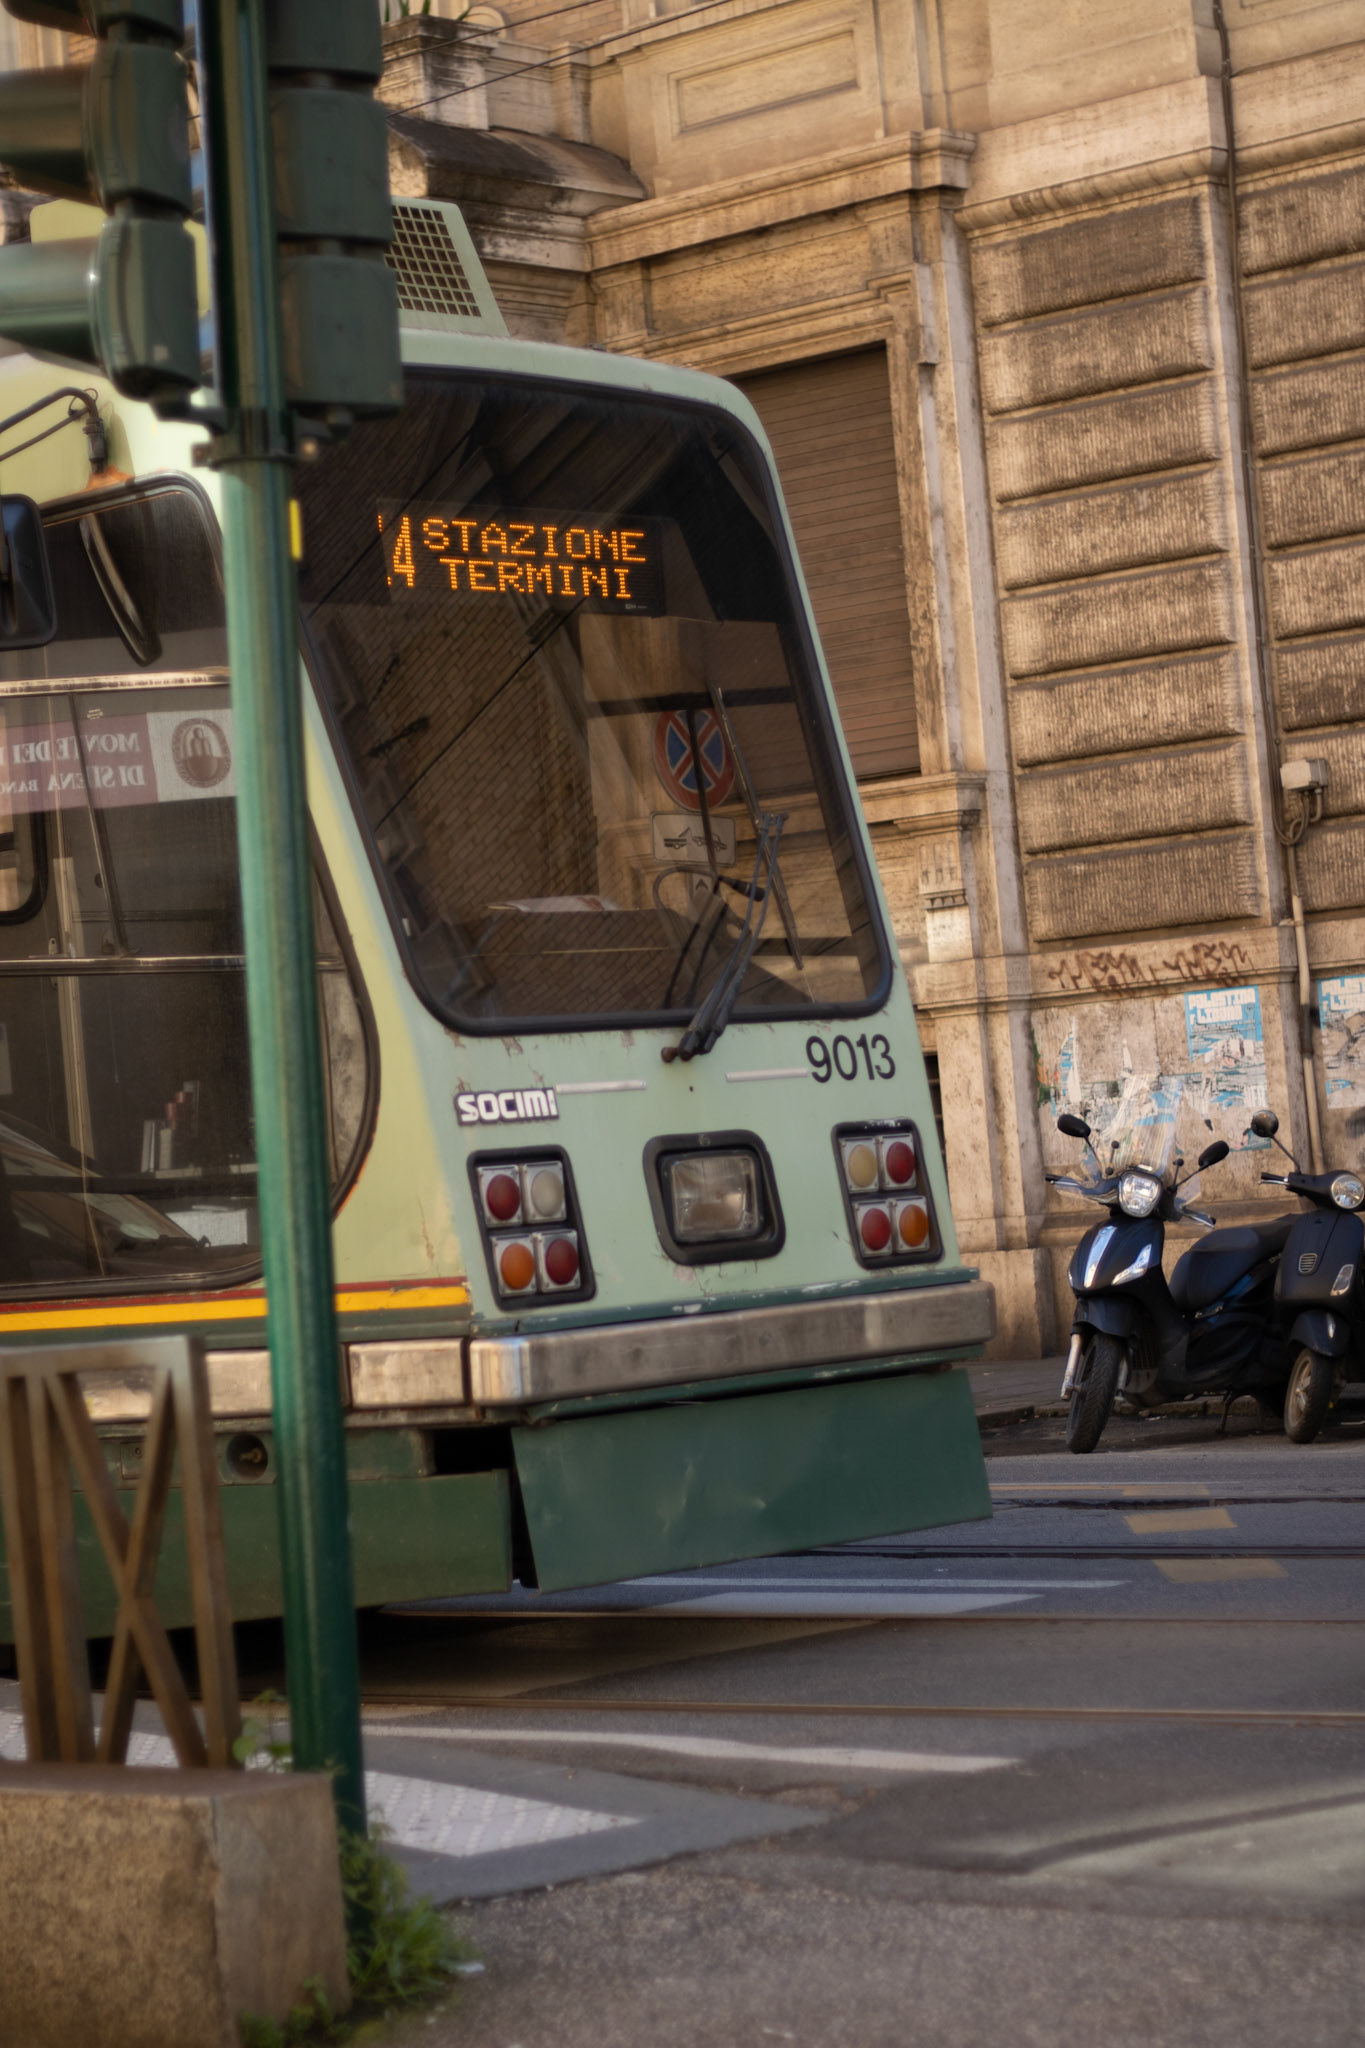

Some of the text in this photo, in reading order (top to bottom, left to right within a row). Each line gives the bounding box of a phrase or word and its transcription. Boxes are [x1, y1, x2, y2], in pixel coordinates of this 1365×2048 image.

[422, 518, 646, 562] STAZIONE
[439, 558, 631, 599] TERMINI
[806, 1033, 896, 1084] 9013
